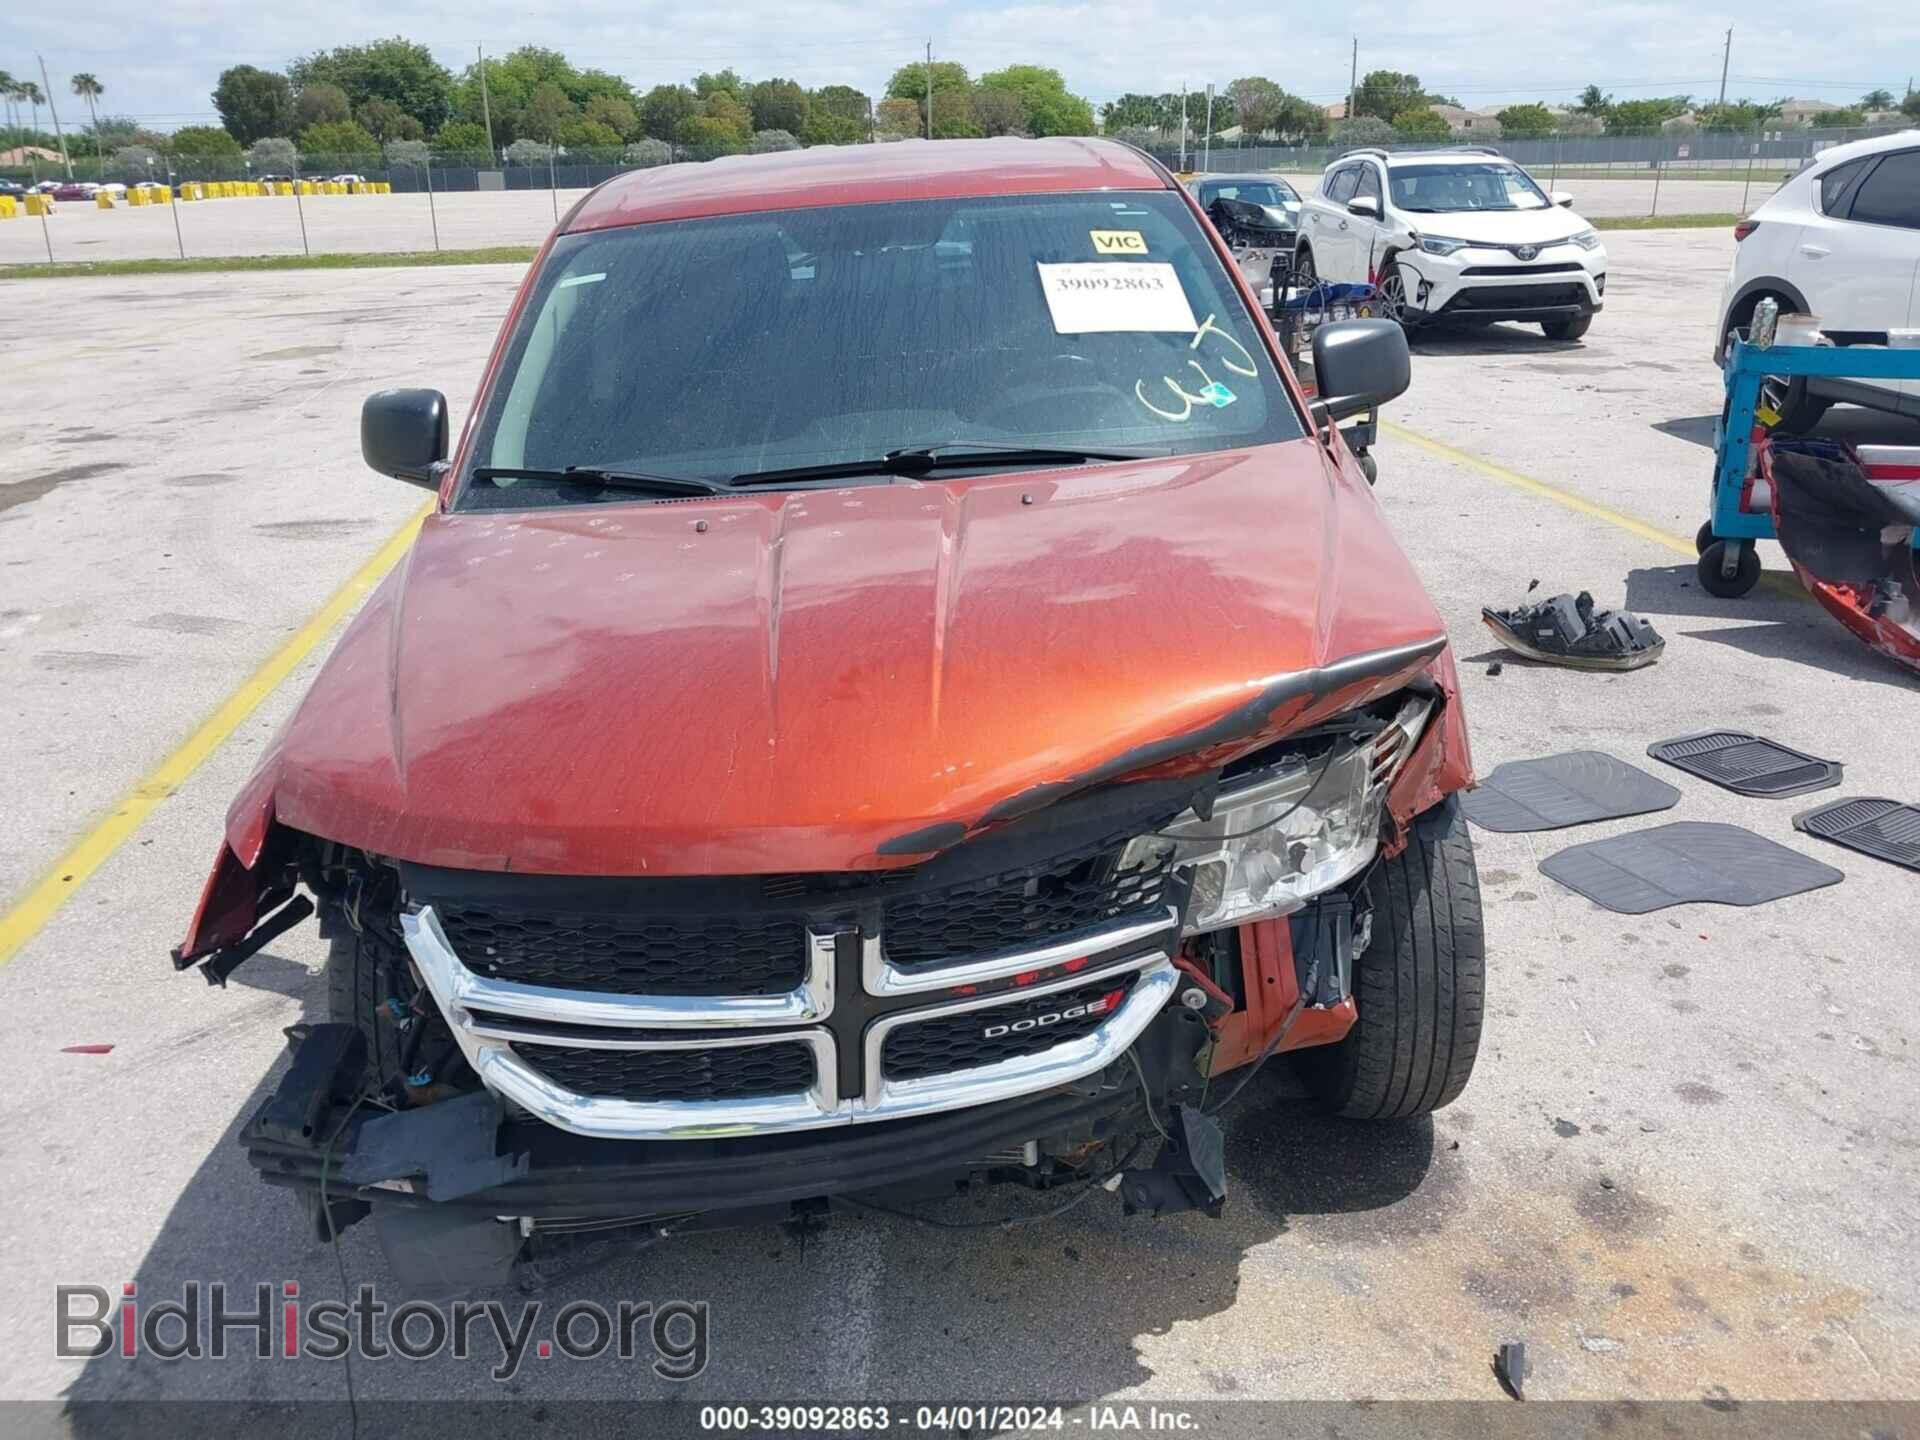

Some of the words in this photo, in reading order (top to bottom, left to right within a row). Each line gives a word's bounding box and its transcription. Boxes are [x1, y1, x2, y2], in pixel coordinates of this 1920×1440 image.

[1096, 235, 1141, 249] VIC
[1055, 277, 1165, 292] 39092863
[984, 999, 1109, 1039] DODGE
